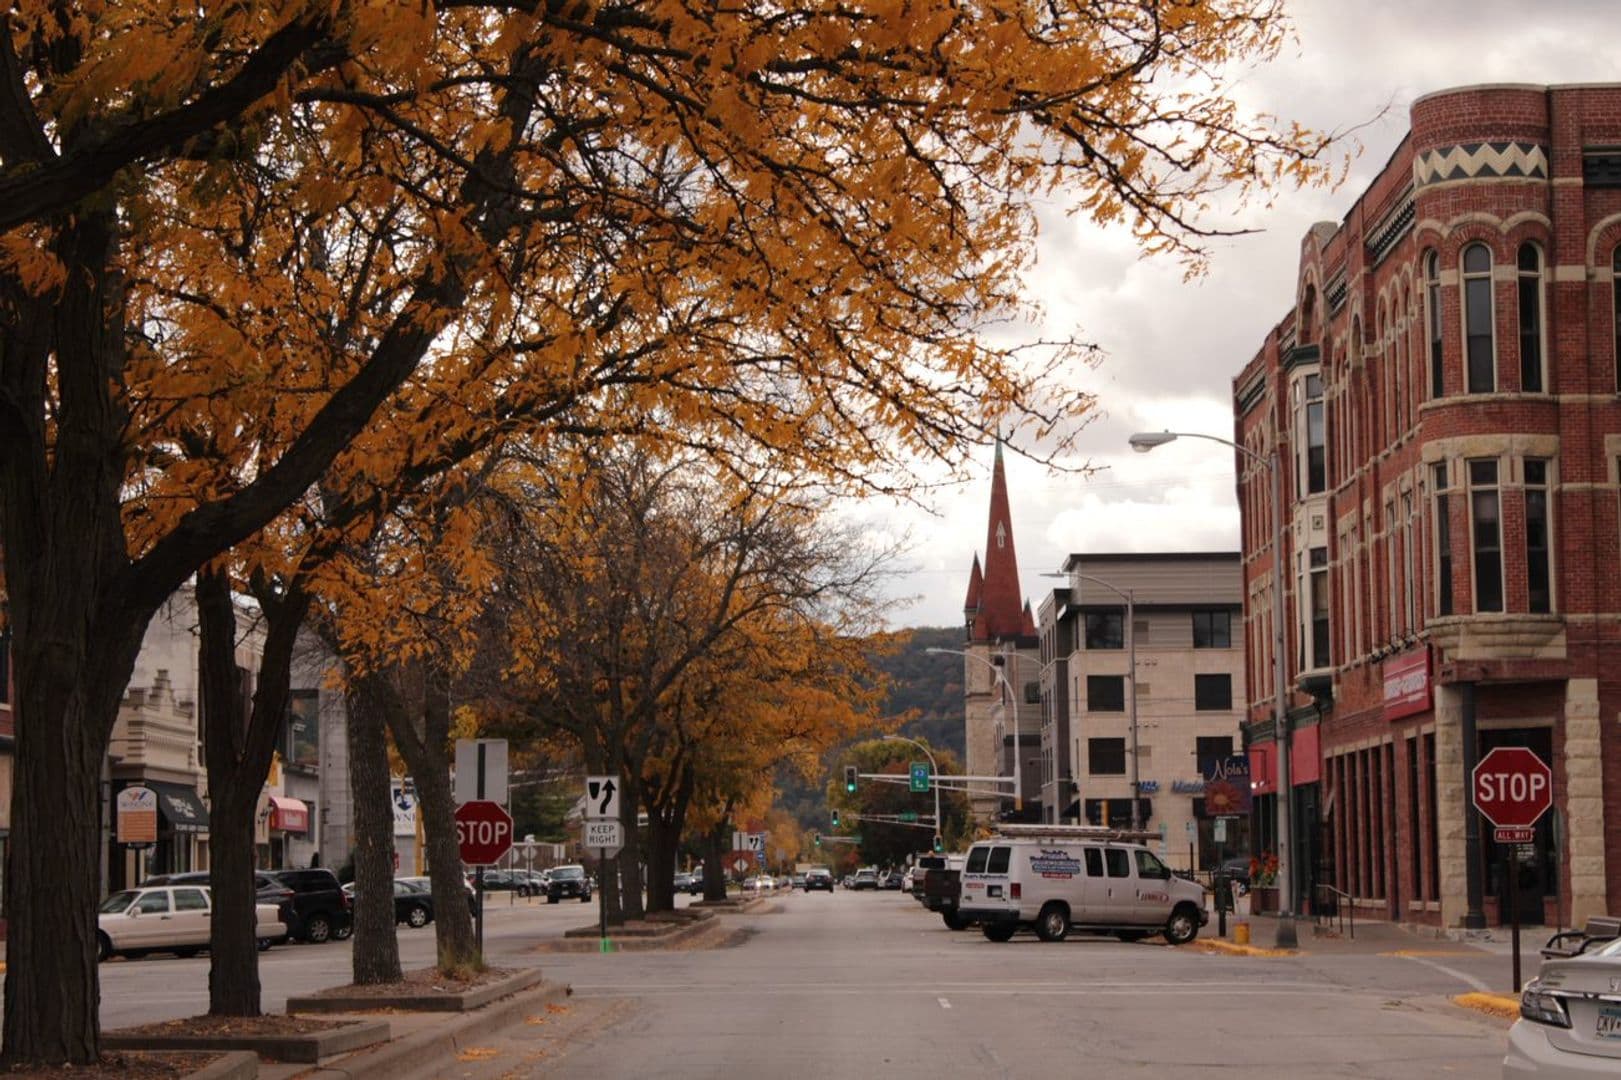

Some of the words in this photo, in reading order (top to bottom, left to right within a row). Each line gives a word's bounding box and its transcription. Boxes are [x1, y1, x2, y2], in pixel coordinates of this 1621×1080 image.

[1210, 758, 1248, 781] Nola's
[1478, 773, 1546, 802] STOP
[456, 821, 508, 845] STOP
[591, 824, 615, 834] KEEP
[1497, 831, 1511, 840] ALL
[1514, 831, 1529, 840] WAY
[589, 834, 616, 844] RIGHT
